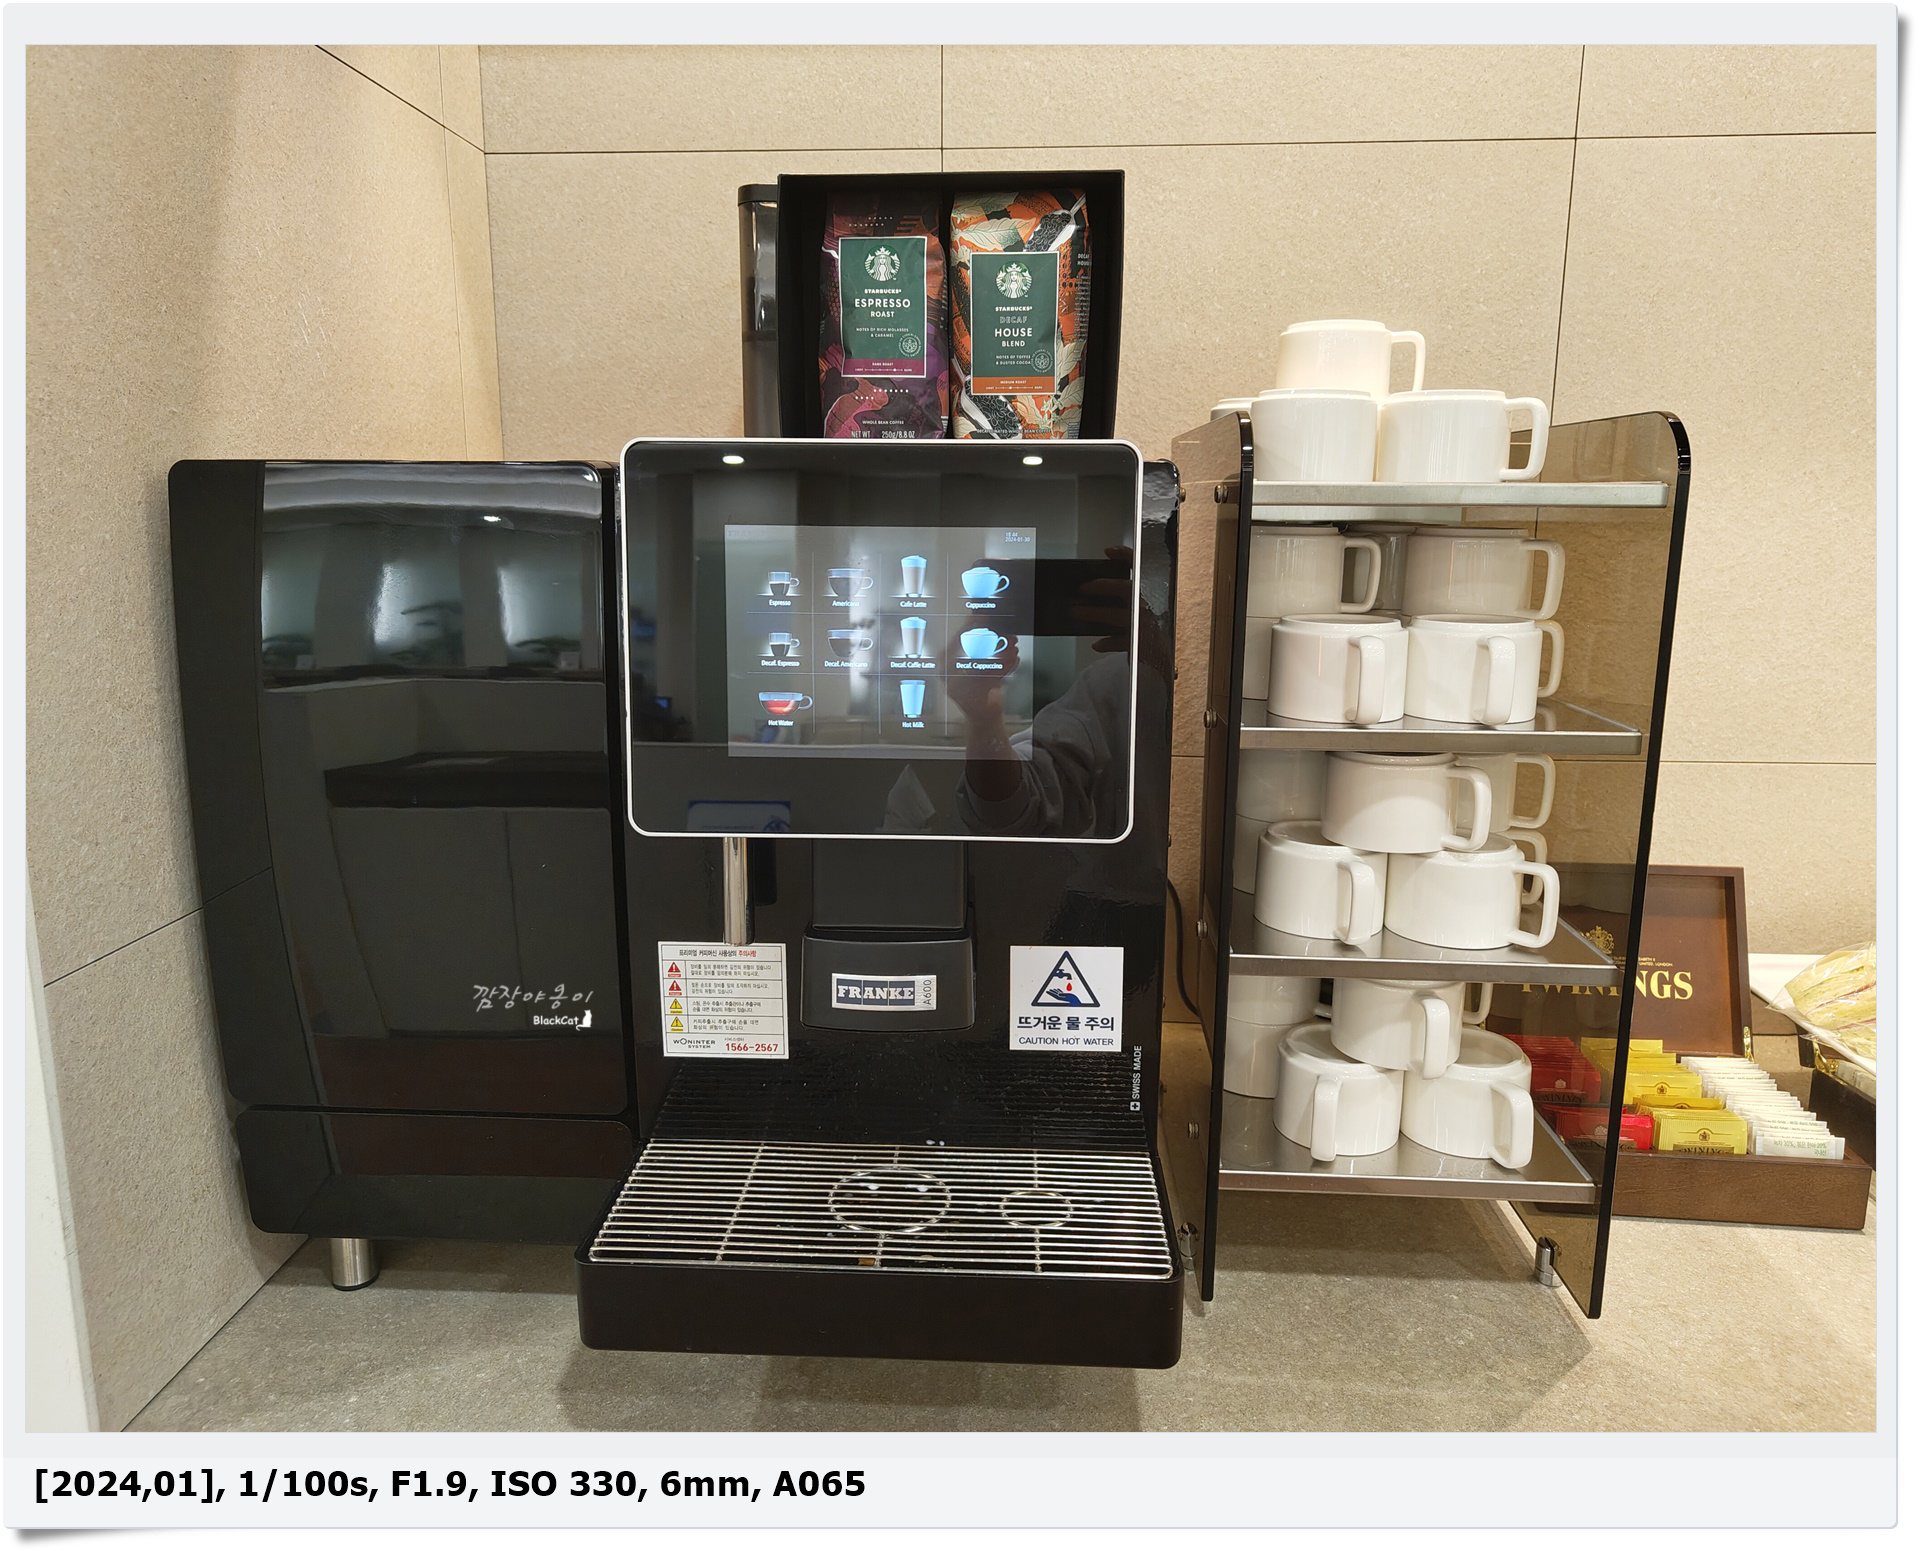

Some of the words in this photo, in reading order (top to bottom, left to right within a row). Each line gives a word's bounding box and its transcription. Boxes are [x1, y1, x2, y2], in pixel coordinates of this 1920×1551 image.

[855, 298, 911, 308] ESPRESSO
[1000, 316, 1028, 324] DECAF
[994, 327, 1033, 337] HOUSE
[851, 430, 861, 438] NET
[769, 599, 791, 608] Espresso
[965, 601, 996, 610] Cappuccino
[776, 660, 800, 668] Espresso
[840, 660, 868, 668] Americano
[972, 662, 1003, 671] Cappuccino
[768, 719, 779, 727] Hot
[779, 719, 794, 727] Water
[679, 949, 698, 957] 프리미엄
[836, 985, 915, 1000] FRANKE
[923, 979, 932, 1005] A600
[1017, 1015, 1062, 1031] 뜨거운
[1065, 1015, 1081, 1031] 물
[1084, 1016, 1115, 1031] 주의
[1018, 1036, 1059, 1046] CAUTION
[1061, 1037, 1081, 1046] HOT
[1083, 1037, 1114, 1046] WATER
[725, 1043, 779, 1052] 1566-2567
[1133, 1045, 1142, 1068] MADE
[1132, 1070, 1141, 1099] SWISS
